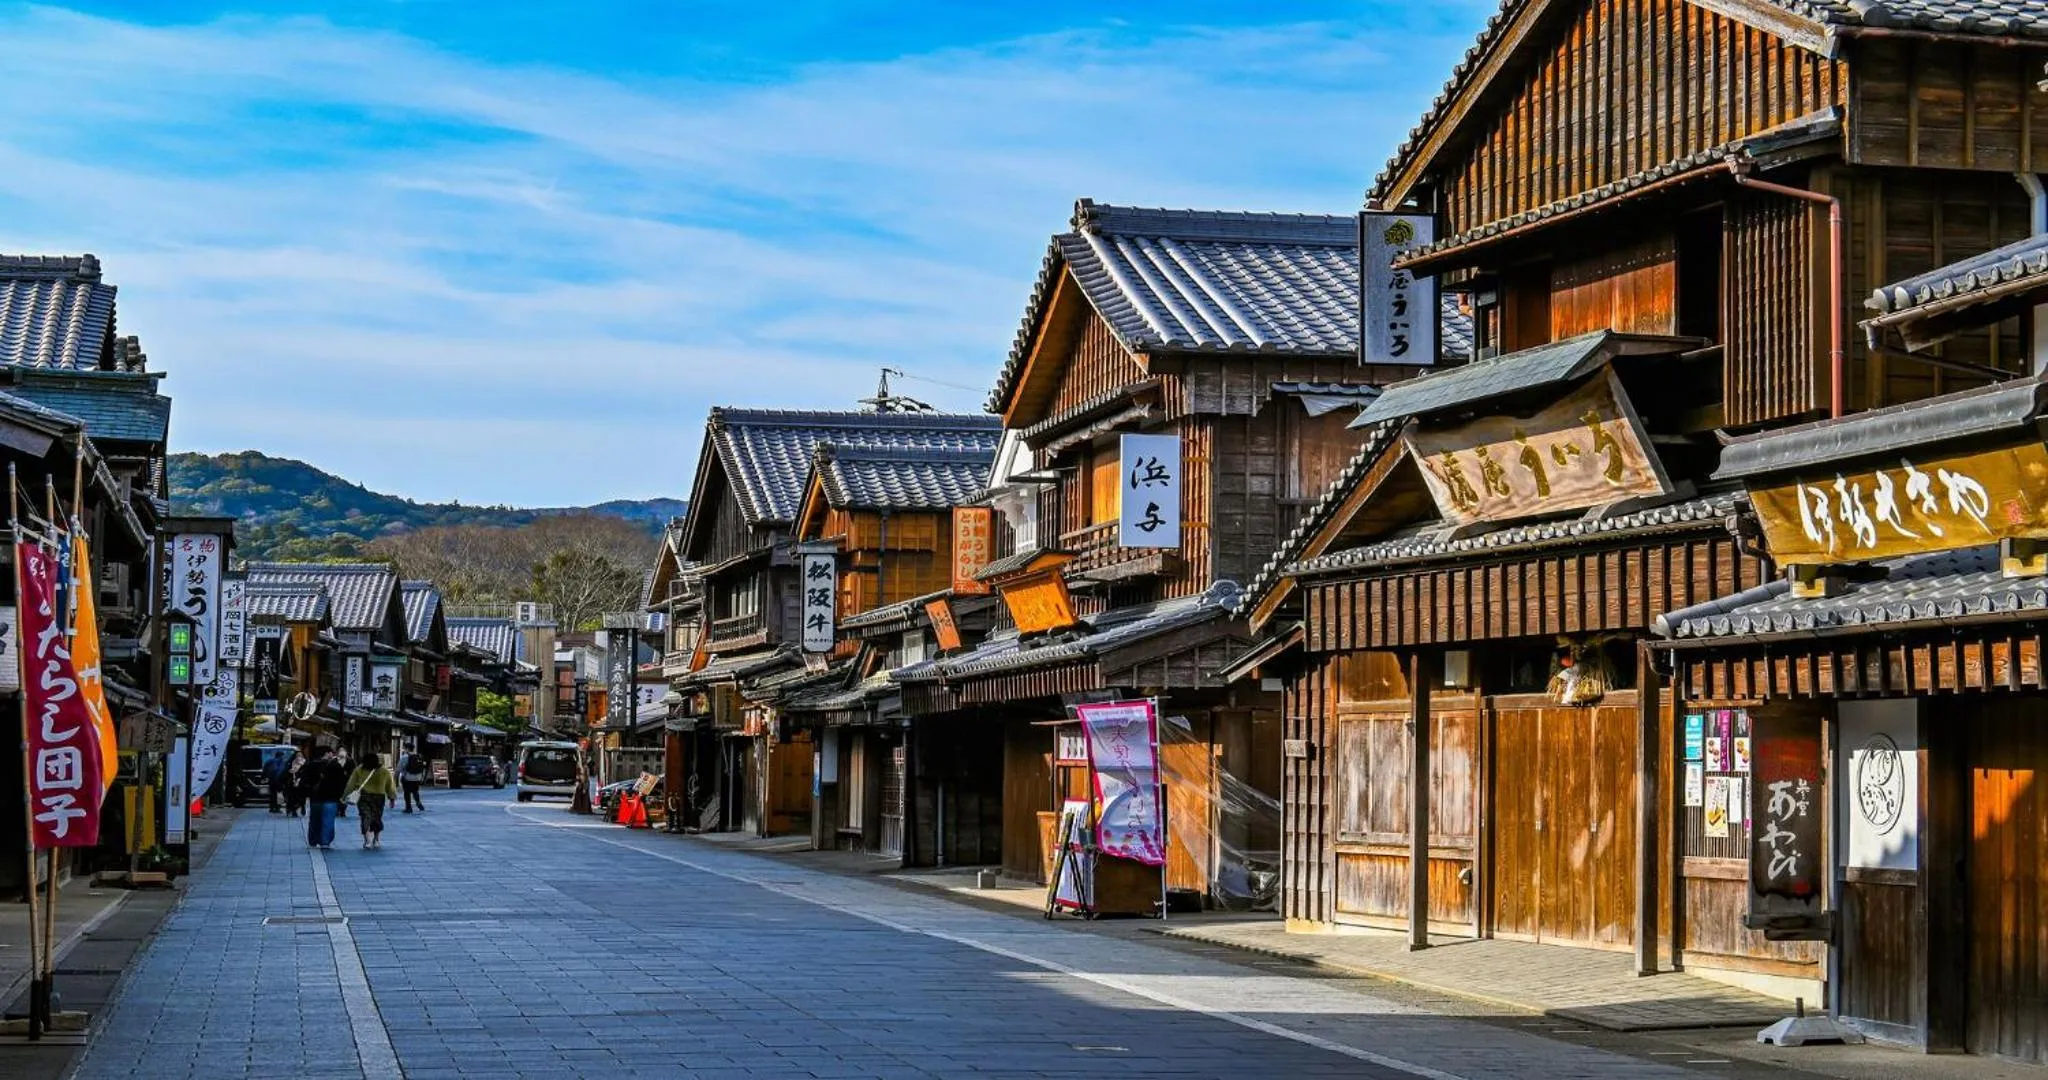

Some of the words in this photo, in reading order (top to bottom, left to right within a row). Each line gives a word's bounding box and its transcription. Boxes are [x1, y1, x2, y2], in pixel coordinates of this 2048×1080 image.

[1389, 251, 1410, 357] 屋ういろ
[1131, 456, 1171, 532] 浜与
[180, 539, 215, 553] 名物
[806, 560, 832, 633] 松阪牛
[1758, 780, 1802, 880] あわび
